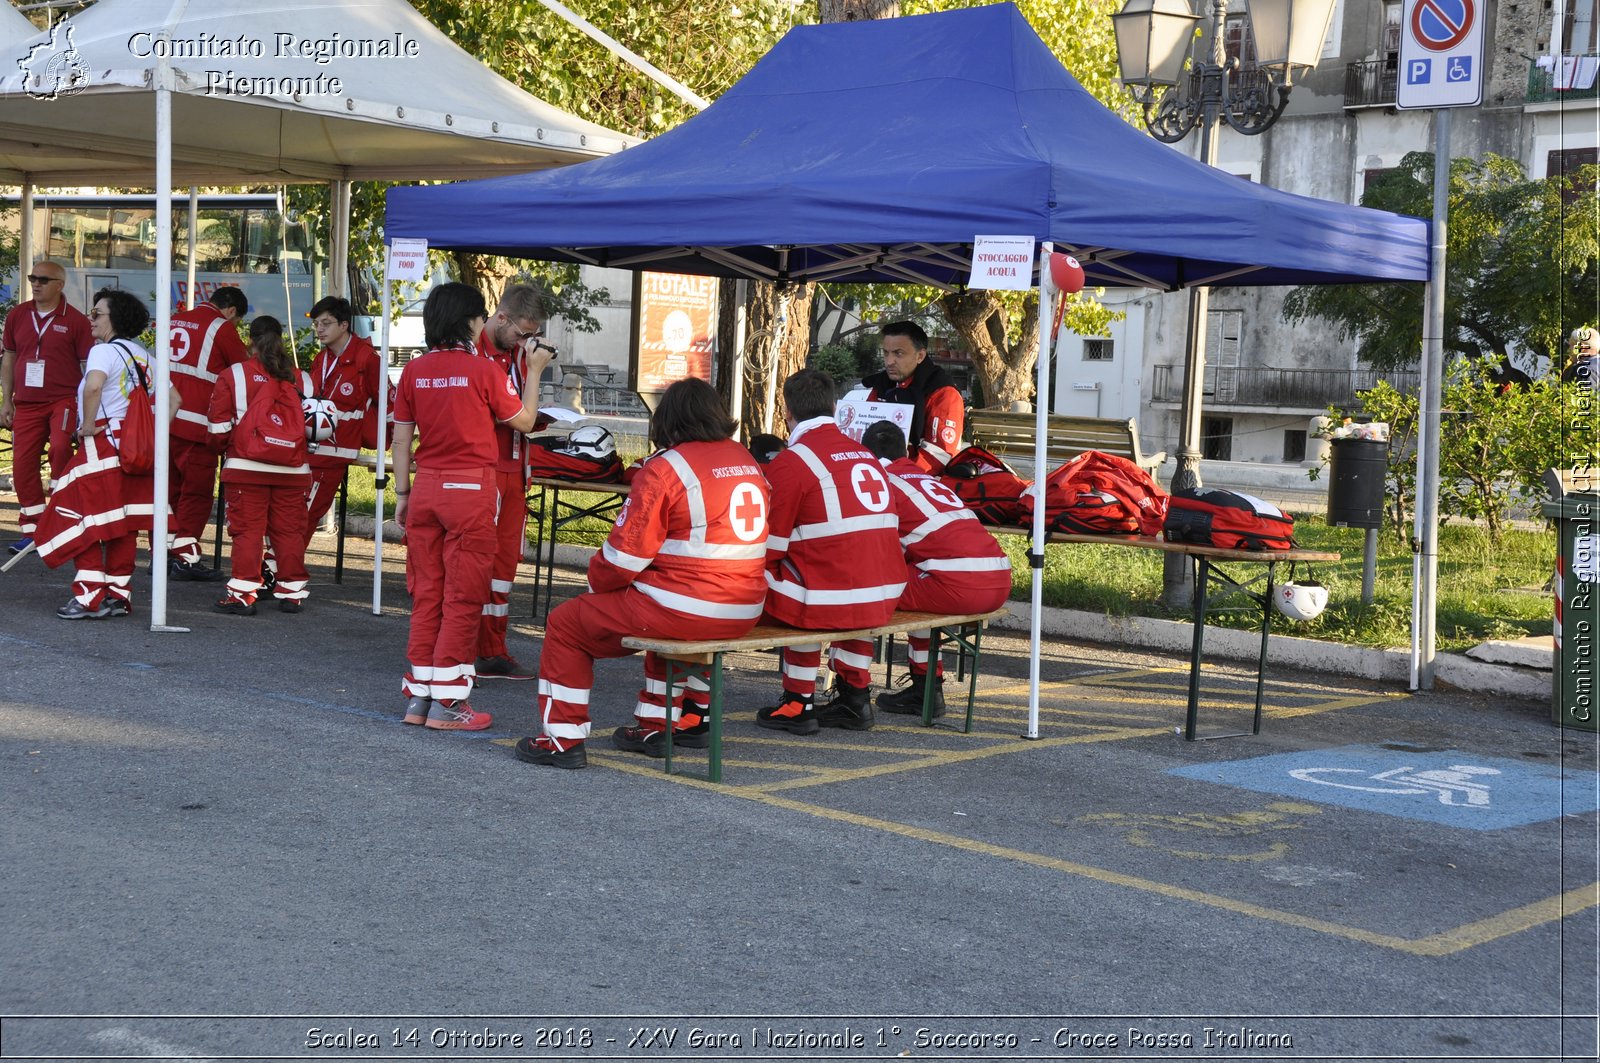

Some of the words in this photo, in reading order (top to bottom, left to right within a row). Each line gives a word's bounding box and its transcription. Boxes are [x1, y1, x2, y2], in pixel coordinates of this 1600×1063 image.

[1411, 61, 1427, 82] P
[978, 253, 1029, 263] STOCCAGGIO
[398, 260, 415, 269] FOOD
[987, 266, 1016, 277] ACQUA
[649, 272, 709, 297] TOTALE
[415, 378, 431, 388] CROCE
[432, 378, 448, 388] ROSSA
[448, 376, 469, 387] ITALIANA
[830, 452, 848, 461] CROCE
[712, 466, 731, 478] CROCE
[729, 465, 744, 476] ROSSA
